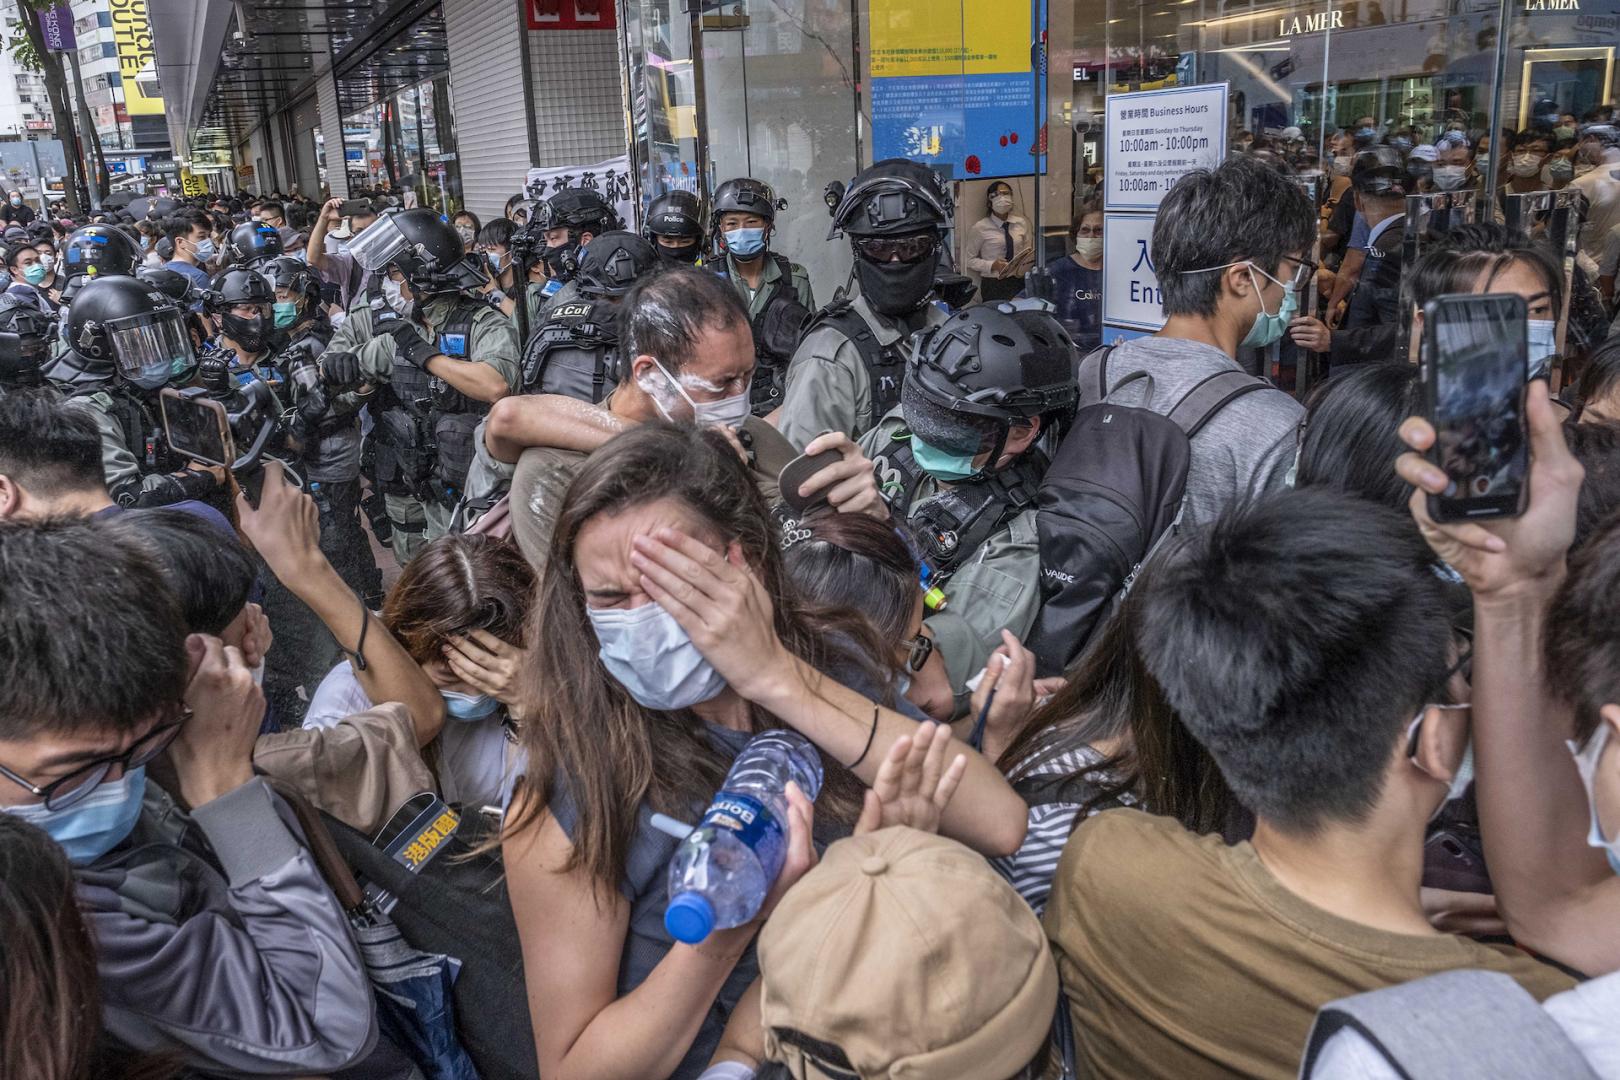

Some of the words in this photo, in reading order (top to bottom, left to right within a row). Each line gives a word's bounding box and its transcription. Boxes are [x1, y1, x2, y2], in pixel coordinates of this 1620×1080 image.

[1279, 17, 1302, 36] LA
[1304, 10, 1344, 33] MER
[51, 20, 62, 48] KONG
[1120, 108, 1149, 120] 營業時間
[1150, 106, 1184, 118] Business
[1184, 104, 1208, 114] Hours
[1179, 125, 1204, 134] Thursday
[1120, 139, 1158, 152] 10:00am
[1166, 135, 1209, 152] 10:00pm
[1120, 178, 1158, 192] 10:00am
[1130, 280, 1163, 305] Ent
[1044, 568, 1074, 584] VAUDE
[402, 808, 458, 866] 港版國
